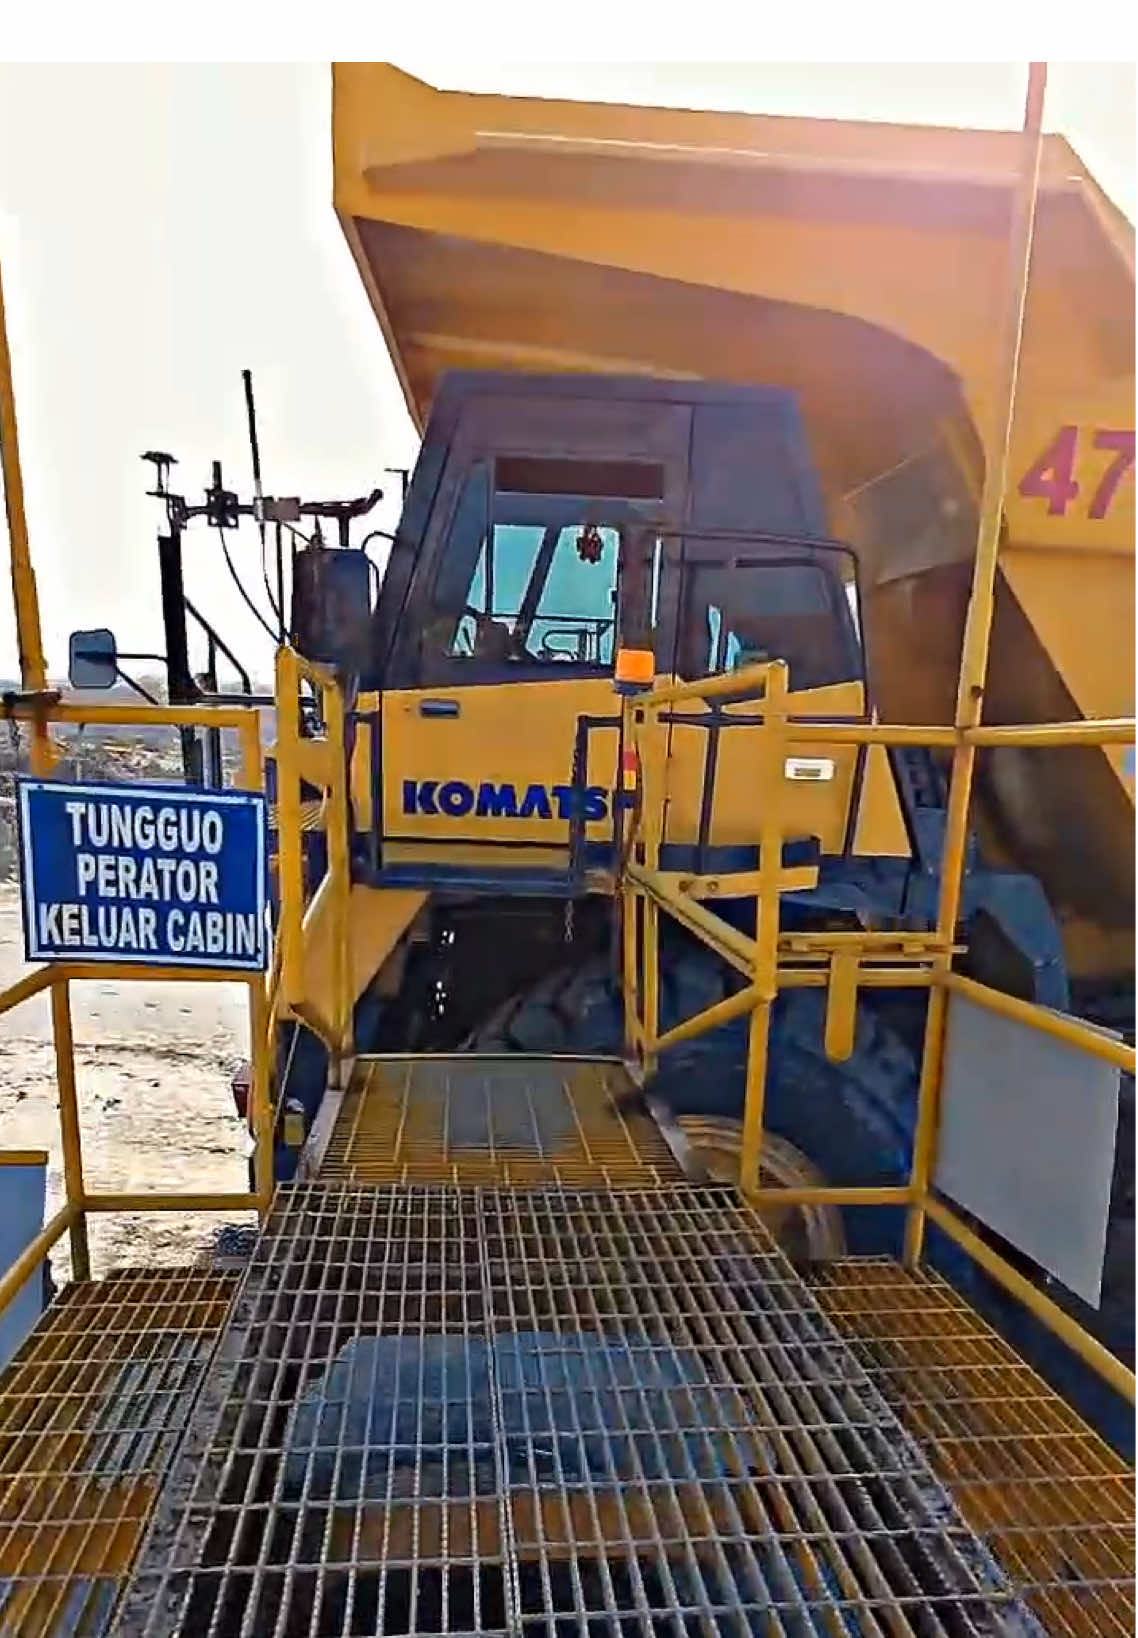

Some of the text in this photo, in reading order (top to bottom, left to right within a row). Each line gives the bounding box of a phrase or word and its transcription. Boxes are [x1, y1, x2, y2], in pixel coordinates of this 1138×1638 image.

[1018, 425, 1136, 519] 47
[66, 802, 224, 854] TUNGGUO
[76, 853, 220, 904] PERATOR
[39, 902, 159, 950] KELUAR
